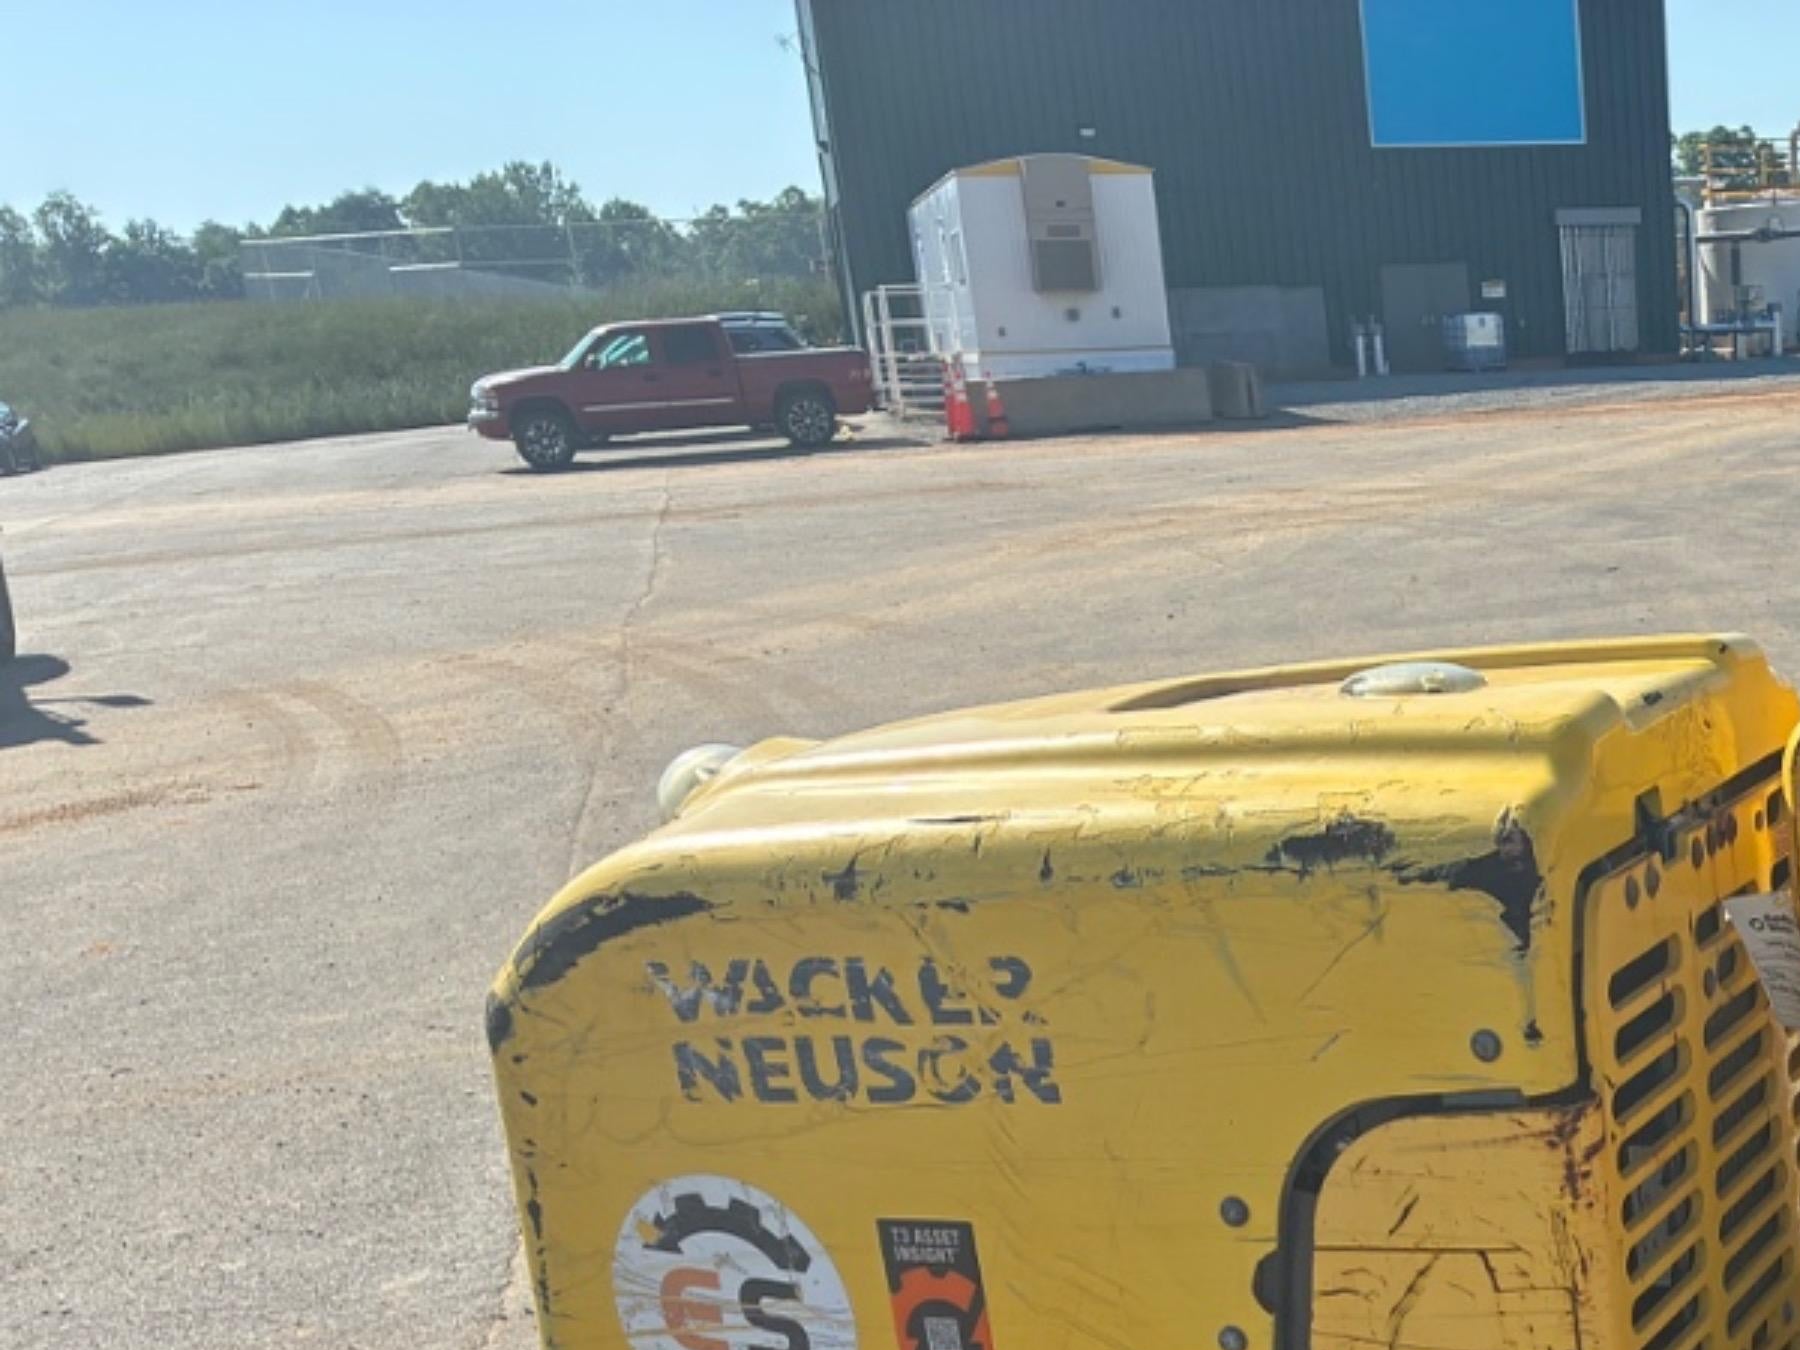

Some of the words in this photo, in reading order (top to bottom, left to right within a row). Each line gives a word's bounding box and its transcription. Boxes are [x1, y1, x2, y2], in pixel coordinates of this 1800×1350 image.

[673, 1035, 1062, 1104] NEUSON
[914, 1228, 961, 1246] ASSET
[893, 1245, 957, 1265] INSIGHT
